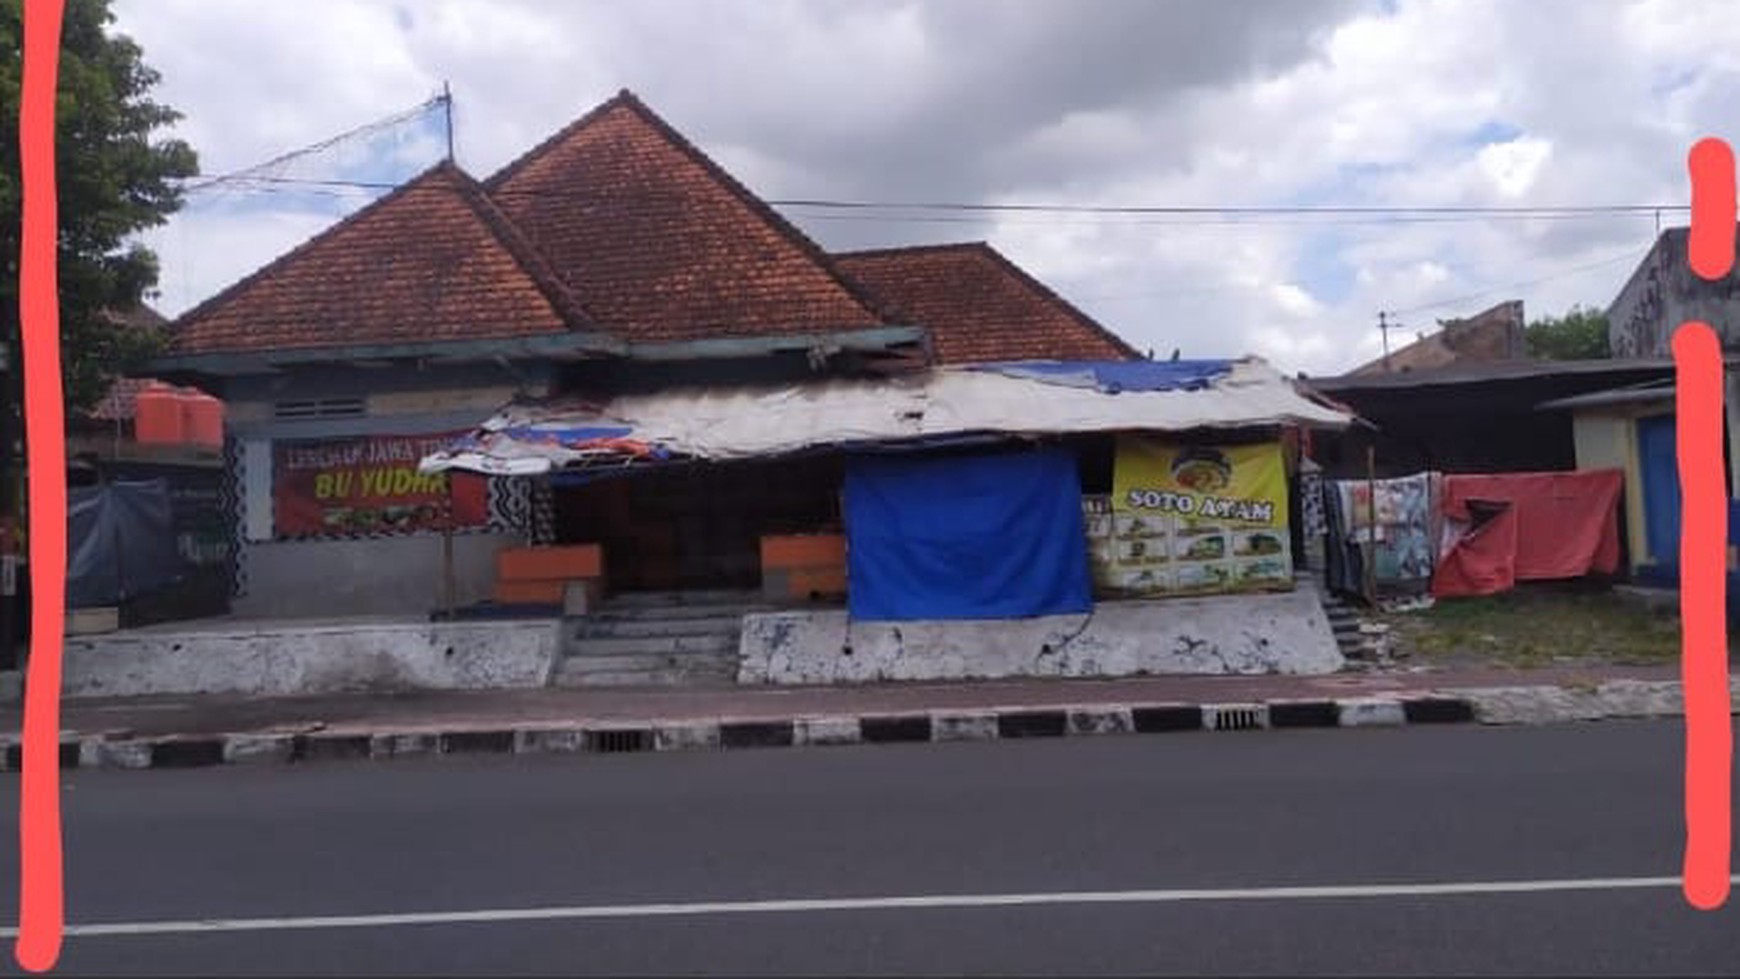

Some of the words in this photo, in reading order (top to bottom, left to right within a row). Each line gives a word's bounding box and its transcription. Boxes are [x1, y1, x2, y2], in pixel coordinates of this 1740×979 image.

[368, 437, 415, 463] JAWA
[315, 472, 353, 499] BU
[1130, 488, 1193, 513] SOTO
[1200, 498, 1272, 521] AYAM
